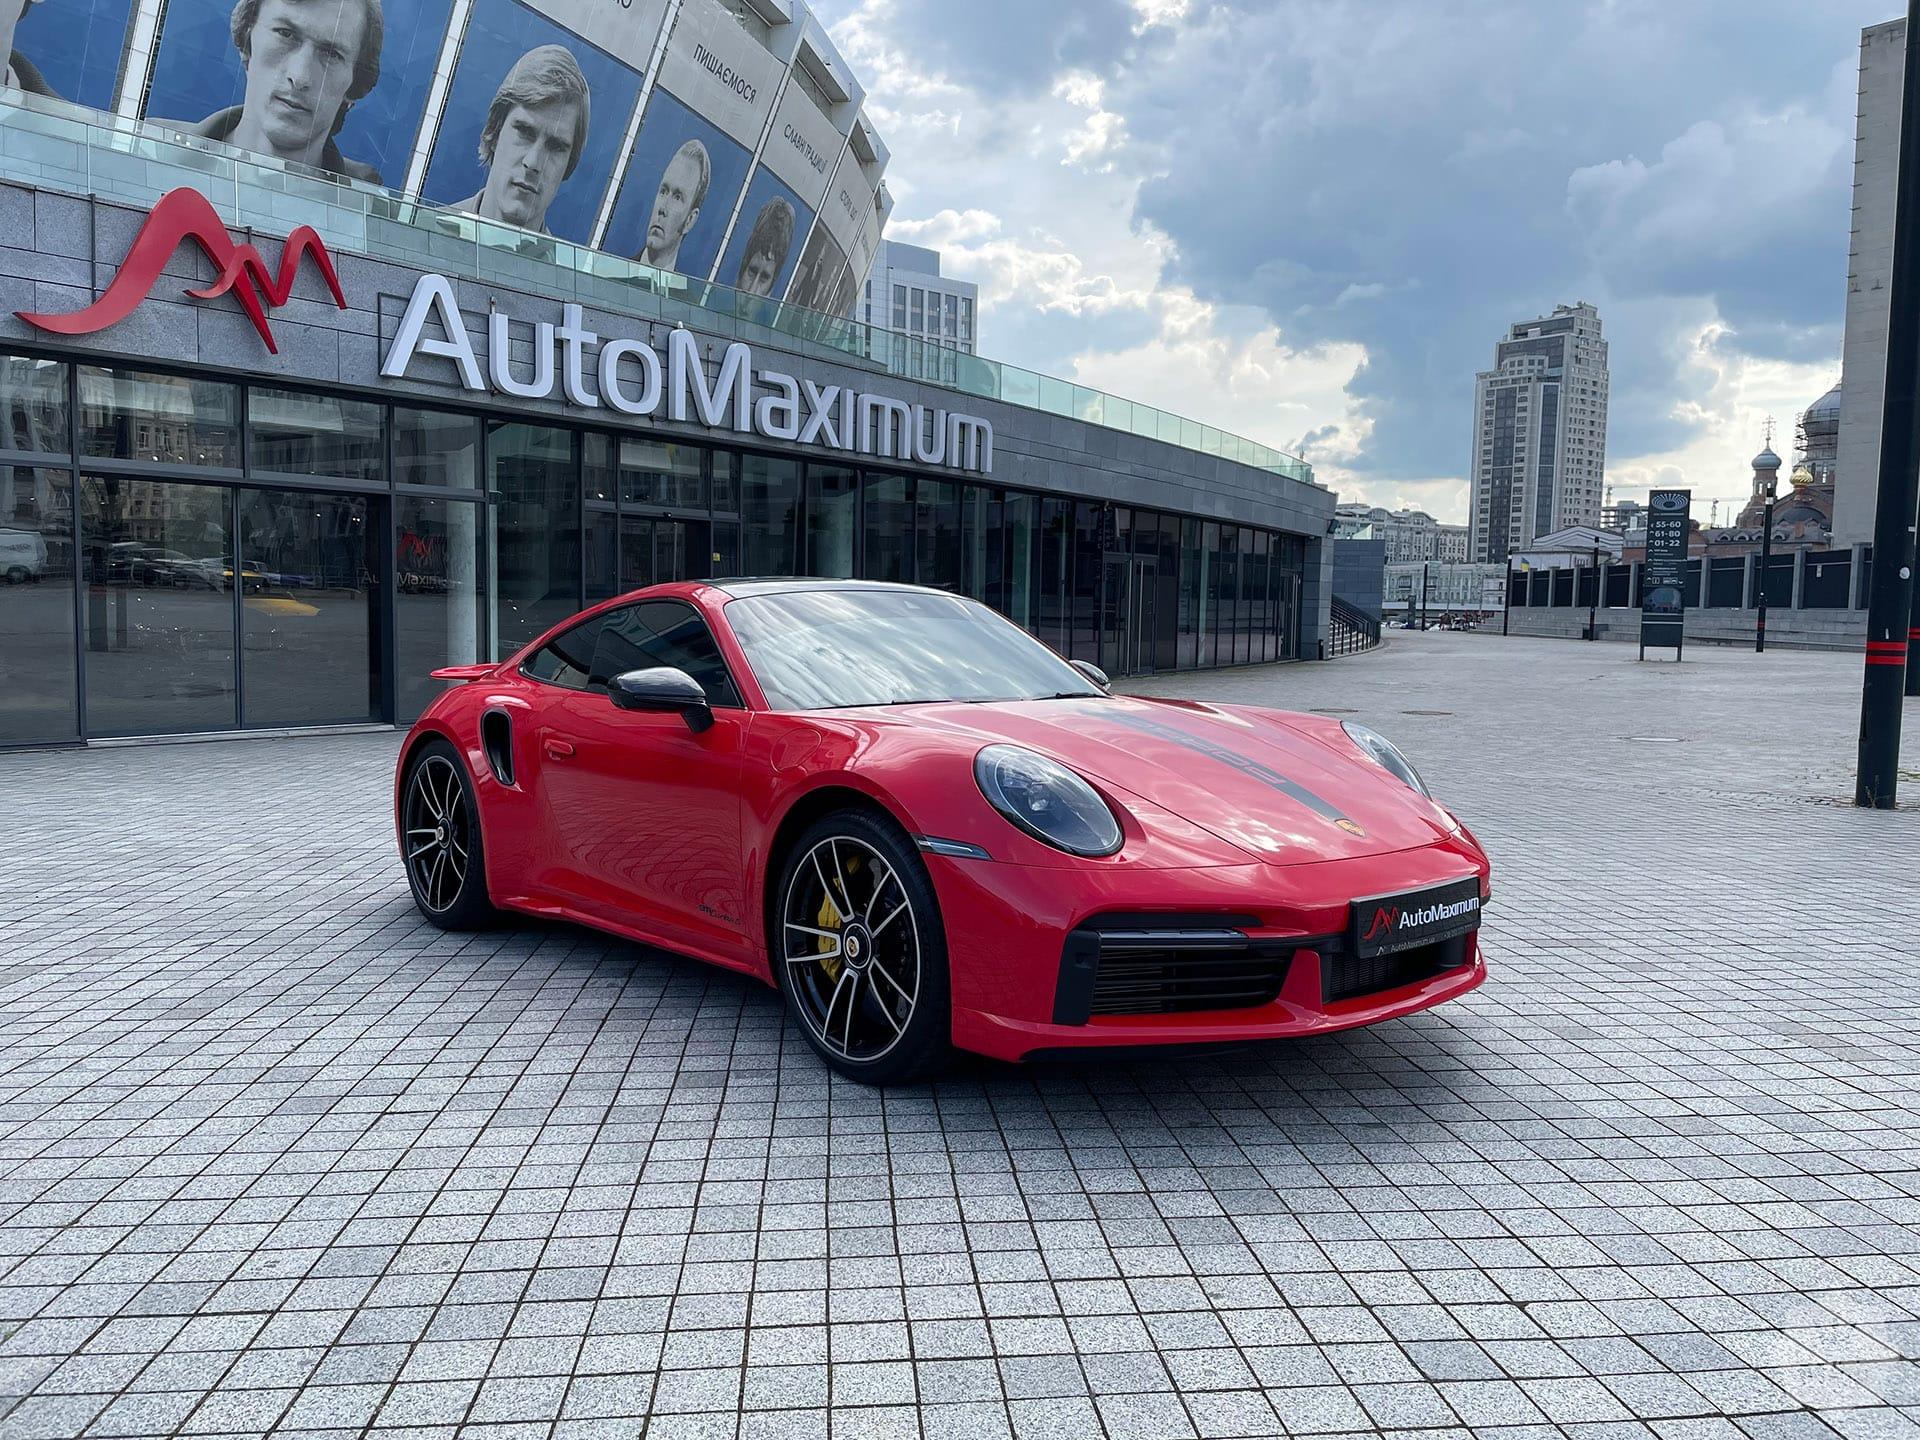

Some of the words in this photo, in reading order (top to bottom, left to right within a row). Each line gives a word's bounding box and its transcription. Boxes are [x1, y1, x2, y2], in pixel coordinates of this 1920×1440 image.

[693, 43, 757, 105] ПИШАЄМОСЯ
[380, 274, 993, 473] AutoMaximum
[1399, 897, 1479, 930] AutoMaximum
